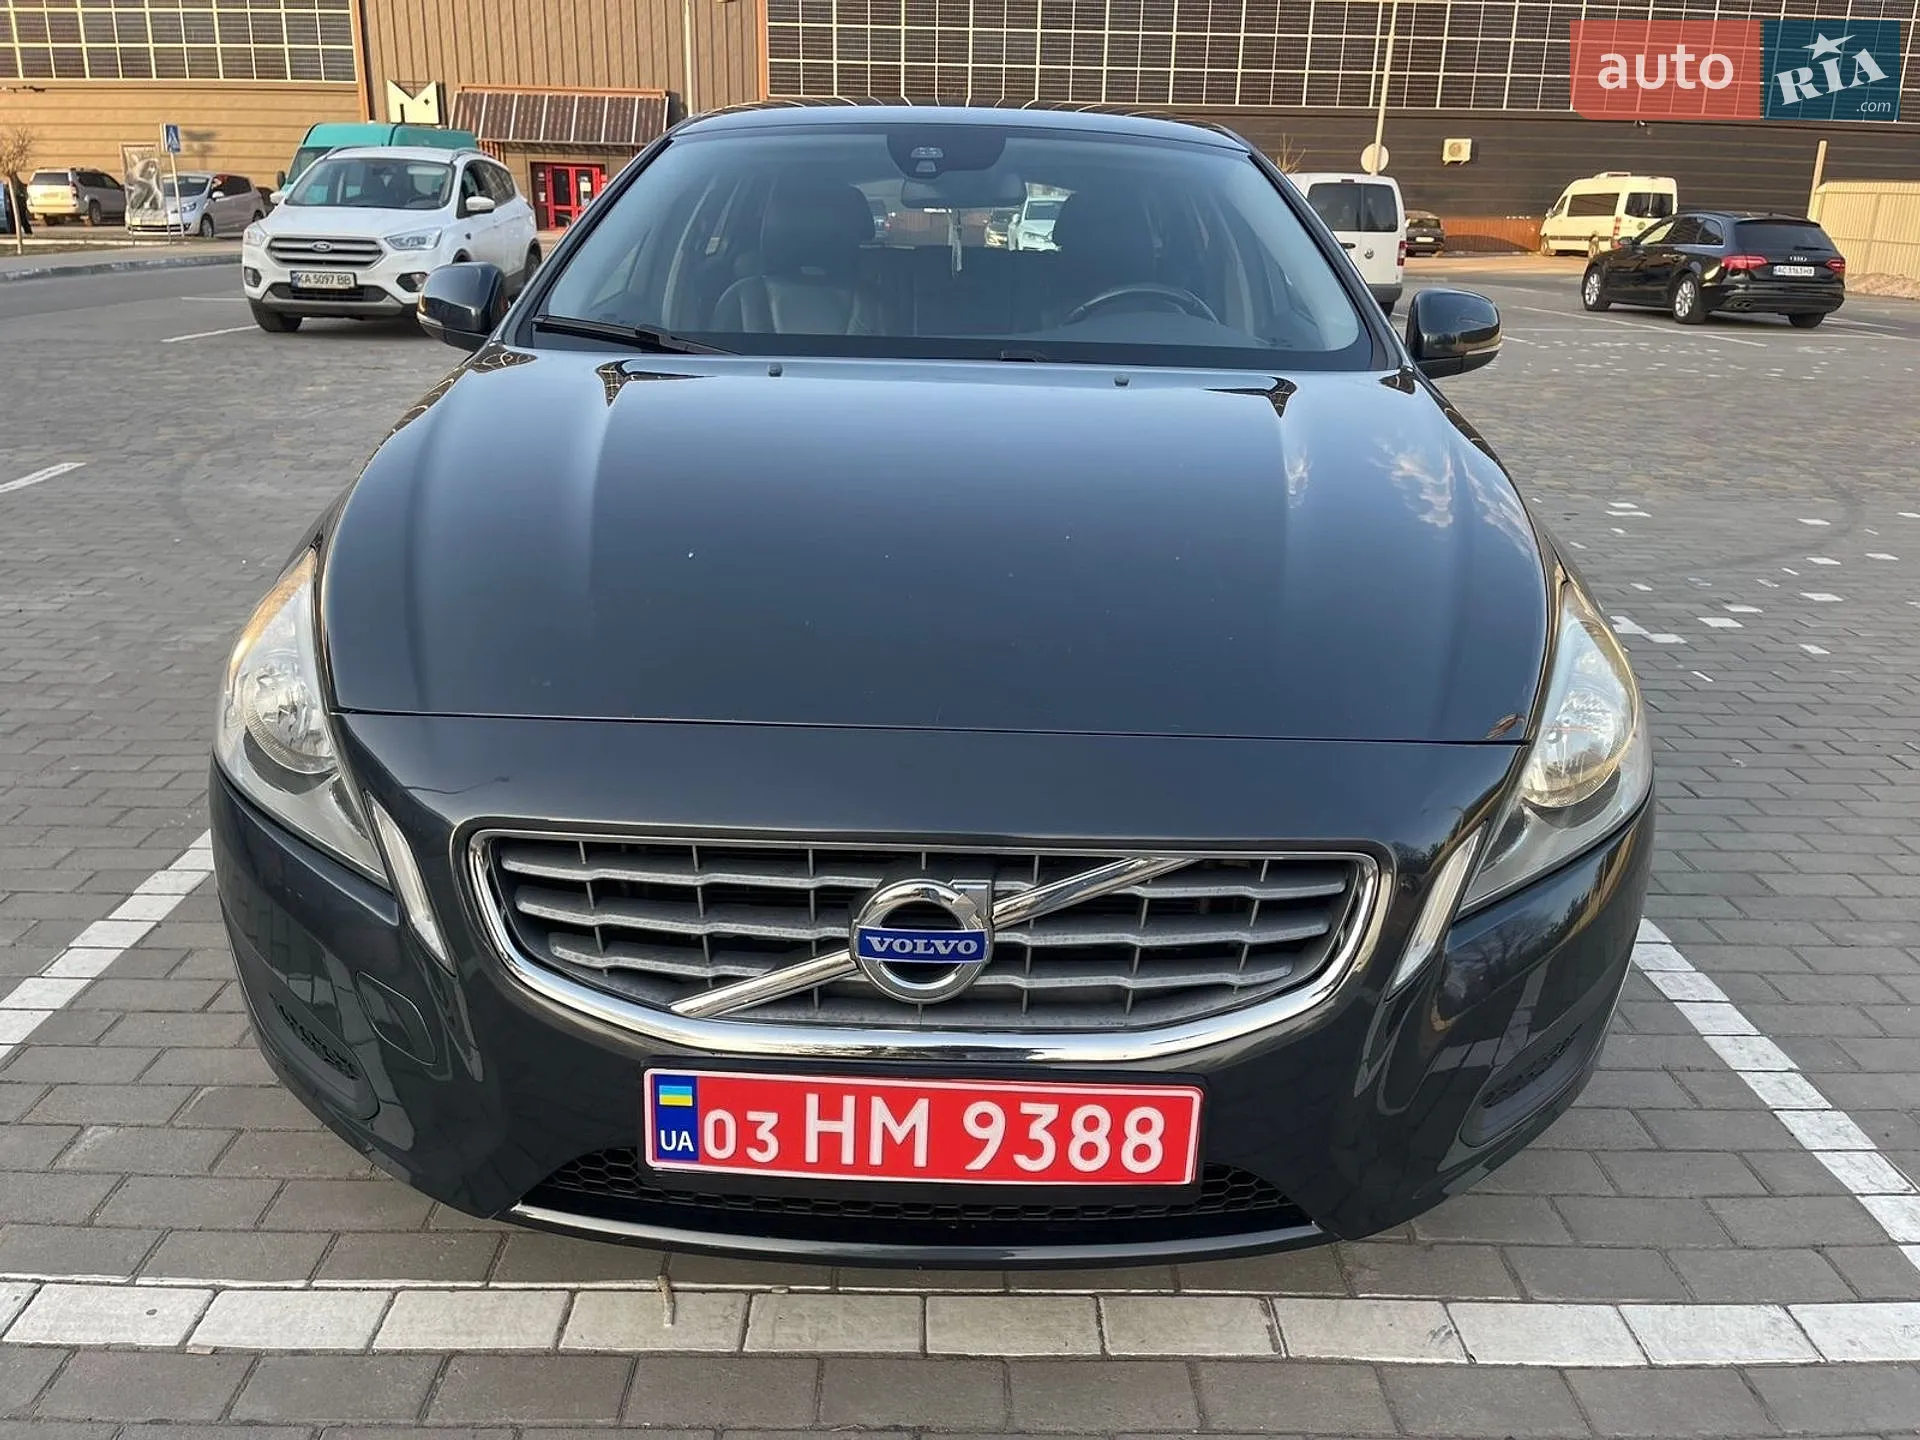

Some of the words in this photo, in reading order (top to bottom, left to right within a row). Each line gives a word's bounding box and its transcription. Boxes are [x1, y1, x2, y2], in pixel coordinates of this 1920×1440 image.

[866, 935, 978, 955] VOLVO
[659, 1129, 695, 1153] UA
[702, 1109, 780, 1164] 03
[804, 1092, 930, 1169] HM
[962, 1102, 1166, 1174] 9388
